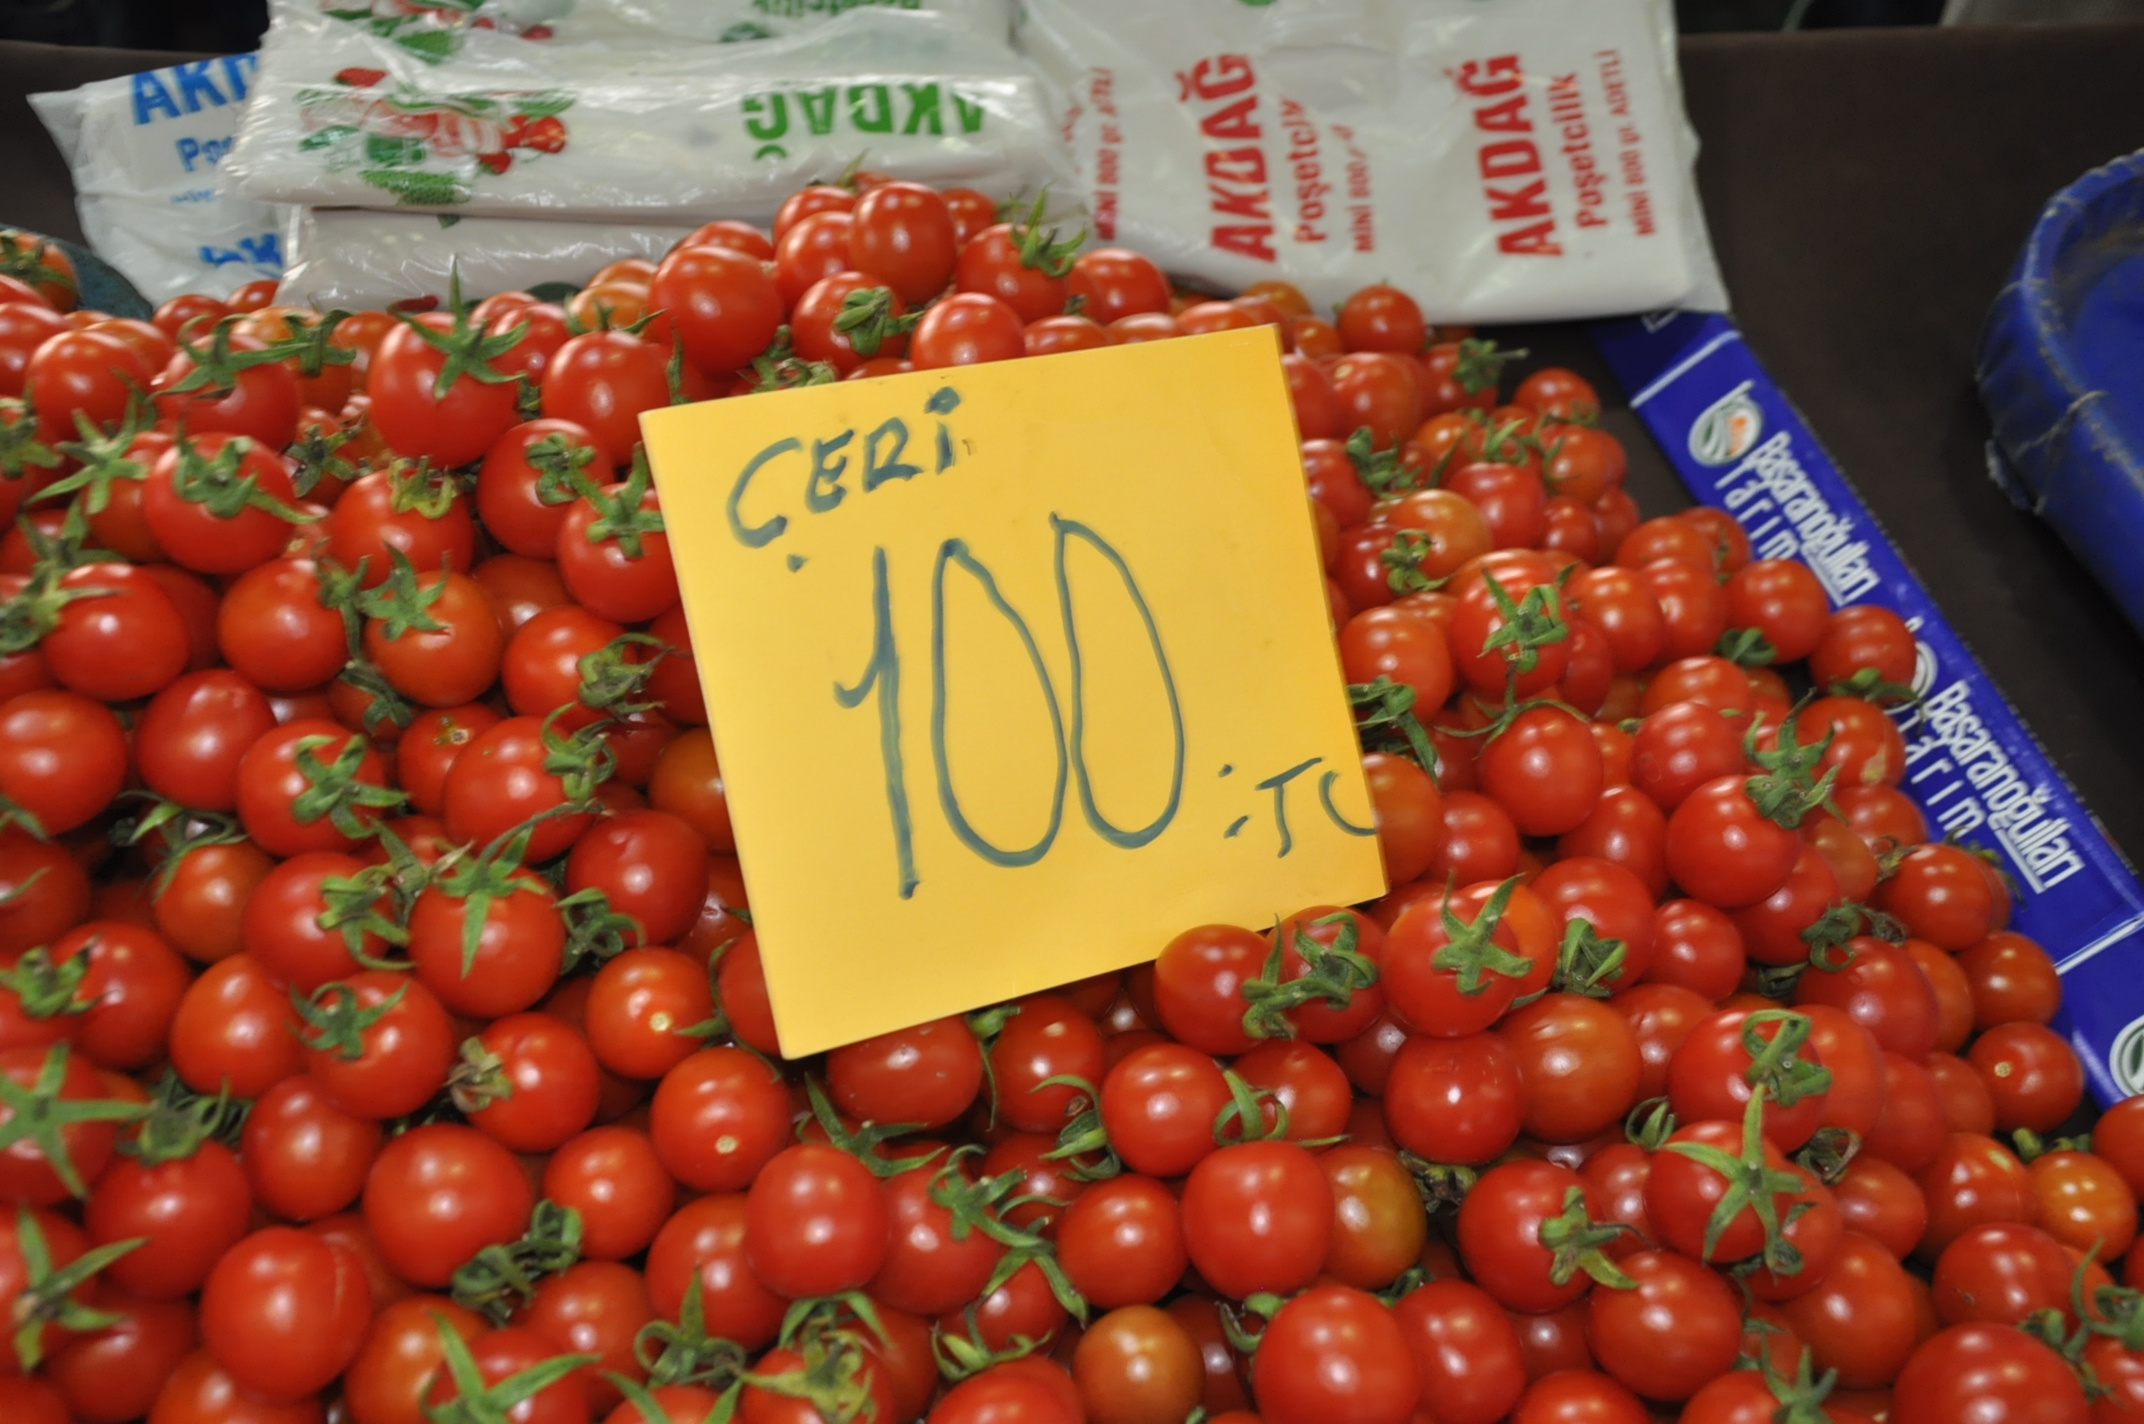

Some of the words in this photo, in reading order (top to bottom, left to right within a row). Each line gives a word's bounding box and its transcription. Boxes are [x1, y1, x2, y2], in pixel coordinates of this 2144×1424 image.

[131, 52, 260, 126] AKD
[1175, 54, 1276, 263] AKDAĞ
[1547, 71, 1608, 229] Poşetcilik
[833, 510, 1186, 900] 100
